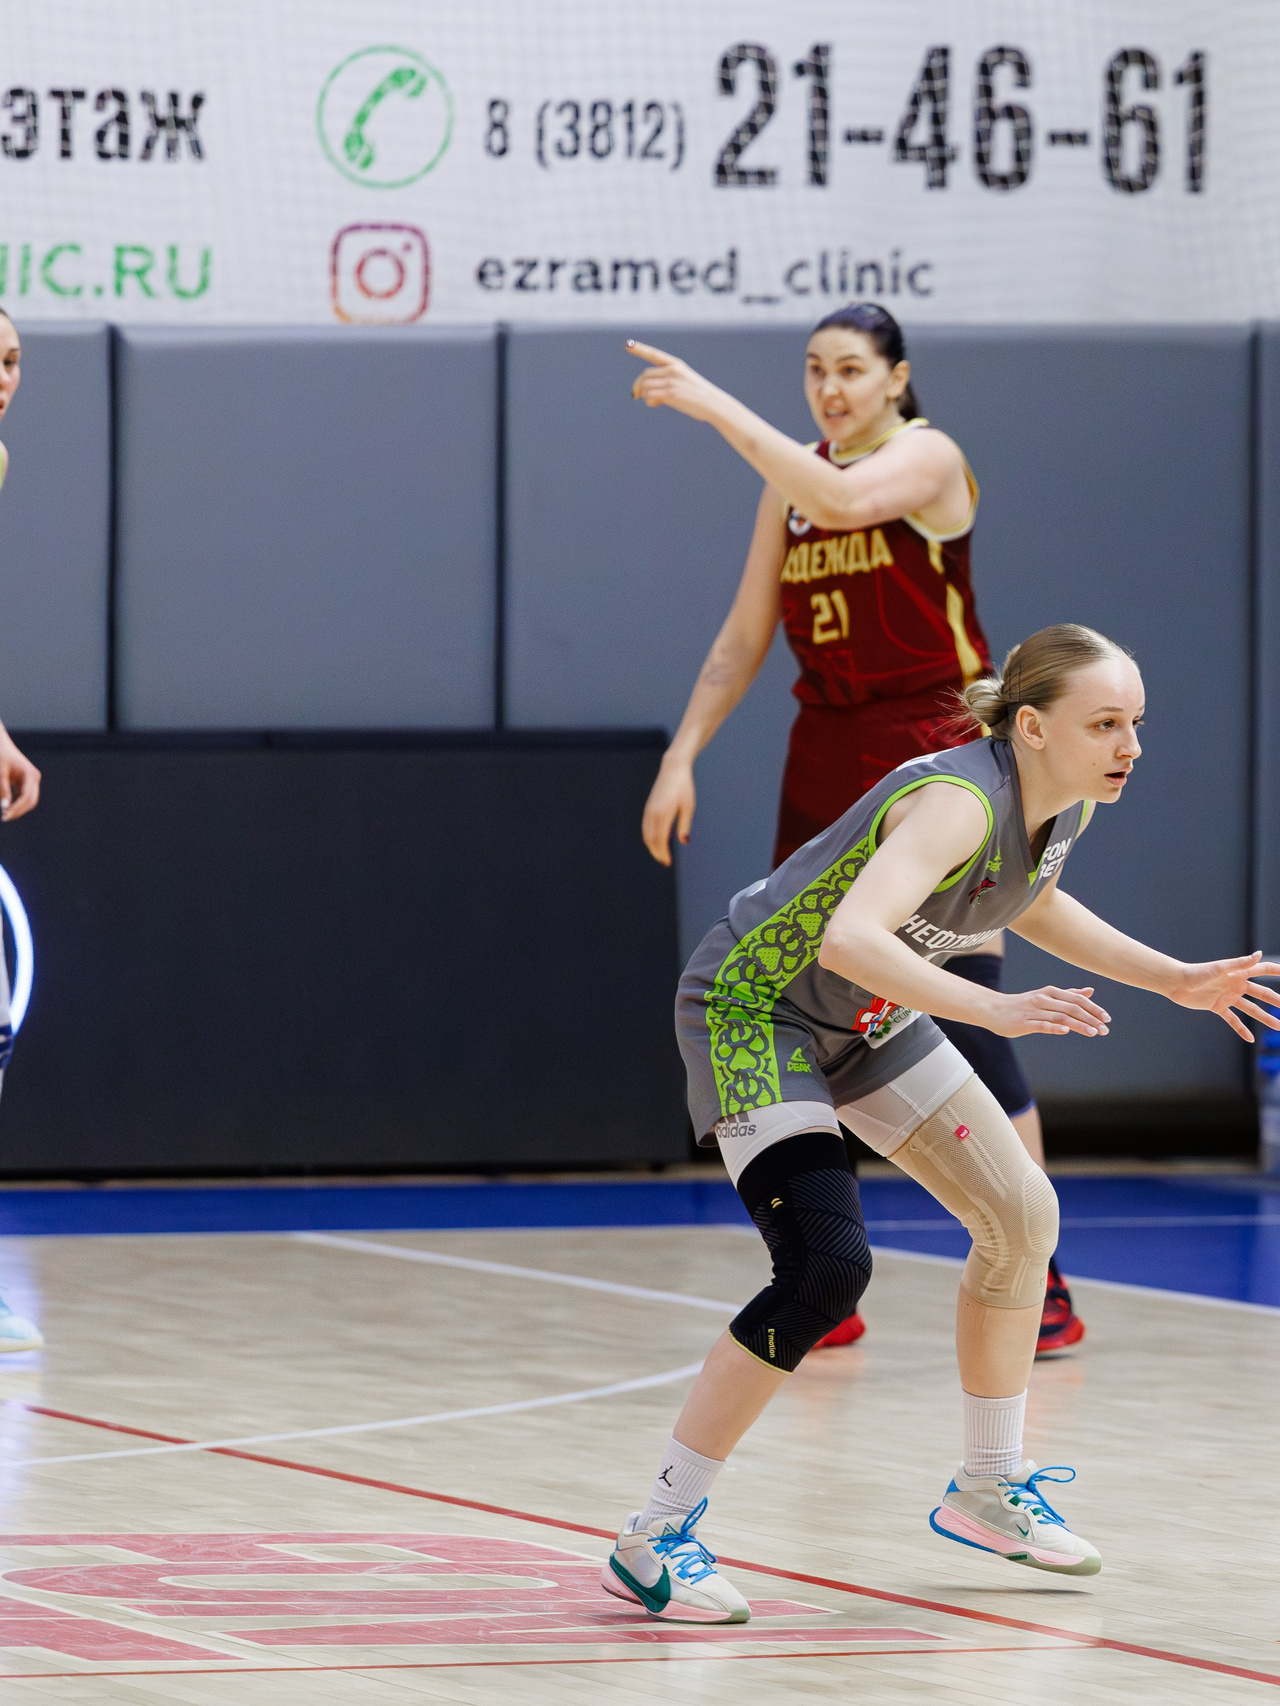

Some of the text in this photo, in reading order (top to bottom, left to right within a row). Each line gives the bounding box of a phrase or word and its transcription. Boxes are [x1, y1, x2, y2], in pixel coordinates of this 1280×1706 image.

[1, 87, 207, 161] этаж
[483, 42, 1209, 195] 8 (3812) 21-46-61
[475, 249, 935, 303] ezramed_clinic
[810, 589, 850, 644] 21
[1042, 837, 1072, 861] FON
[786, 1060, 813, 1074] PEAK
[716, 1121, 757, 1139] adidas
